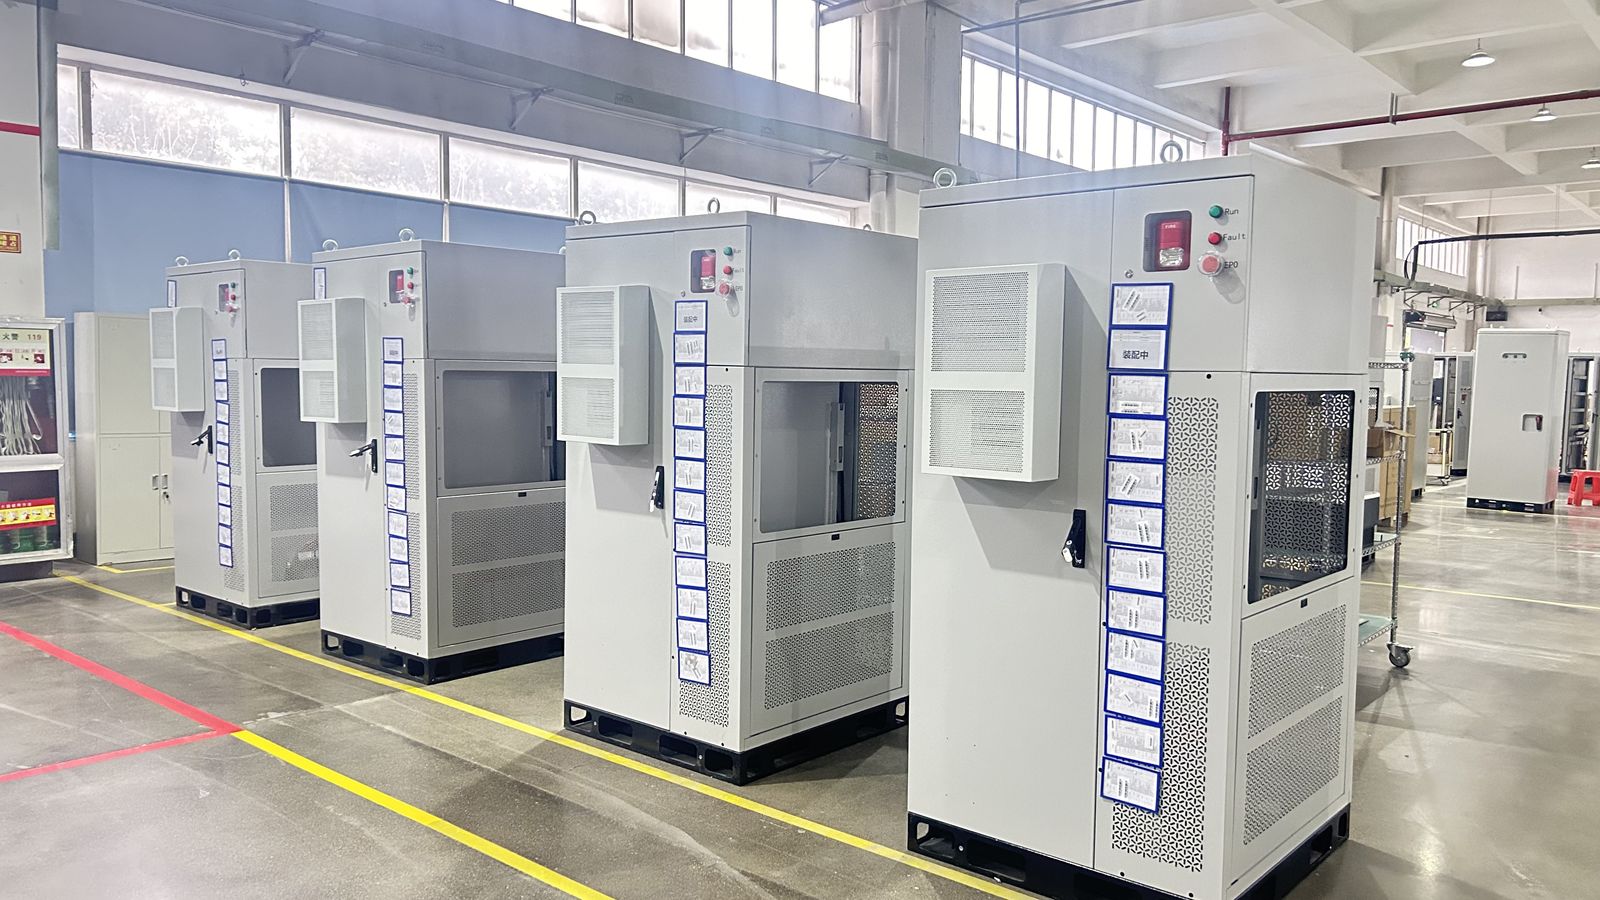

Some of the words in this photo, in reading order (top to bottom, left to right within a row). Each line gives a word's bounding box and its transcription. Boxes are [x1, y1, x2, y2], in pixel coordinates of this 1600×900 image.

[1224, 207, 1239, 215] Run
[1222, 233, 1246, 241] Fault
[1223, 261, 1239, 269] EPO
[1122, 350, 1149, 360] 装配中
